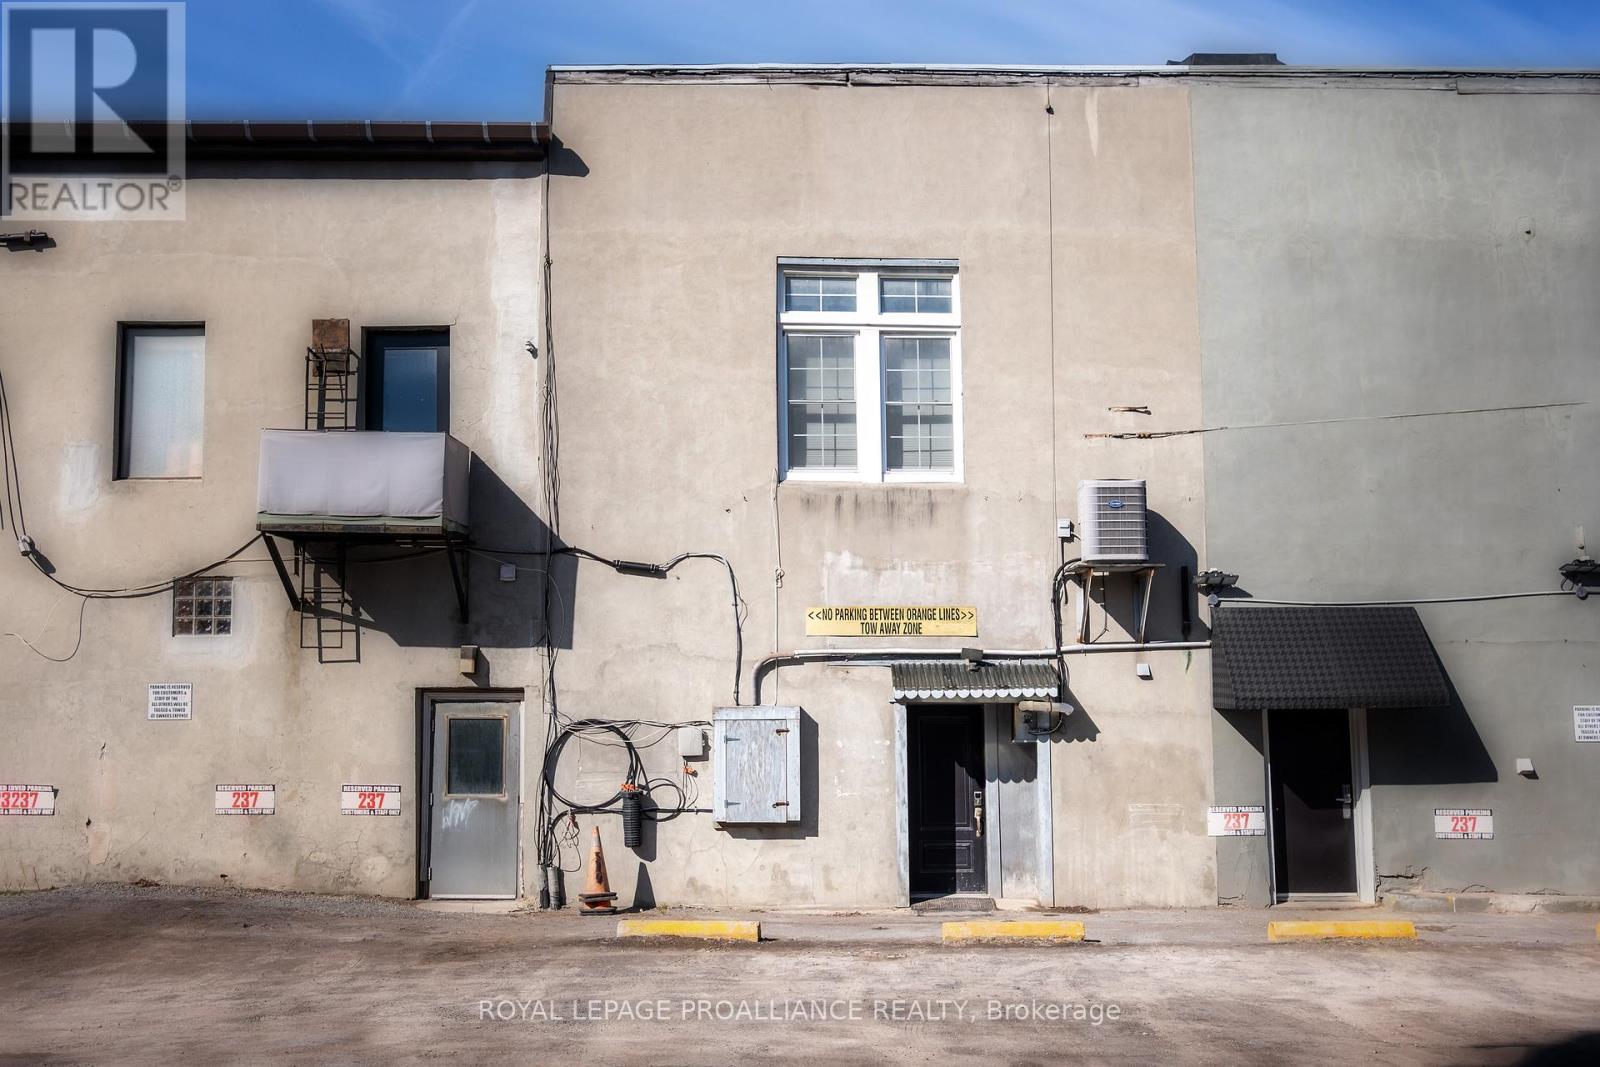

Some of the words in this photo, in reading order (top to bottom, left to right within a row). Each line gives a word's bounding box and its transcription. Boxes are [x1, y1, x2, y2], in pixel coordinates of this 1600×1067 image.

[835, 608, 867, 621] PARKING
[870, 608, 904, 621] BETWEEN
[906, 608, 937, 621] ORANGE
[860, 622, 878, 634] TOW
[879, 622, 901, 634] AWAY
[903, 622, 923, 634] ZONE
[232, 792, 258, 808] 237
[358, 792, 384, 808] 237
[1224, 814, 1249, 829] 237
[1452, 816, 1477, 832] 237
